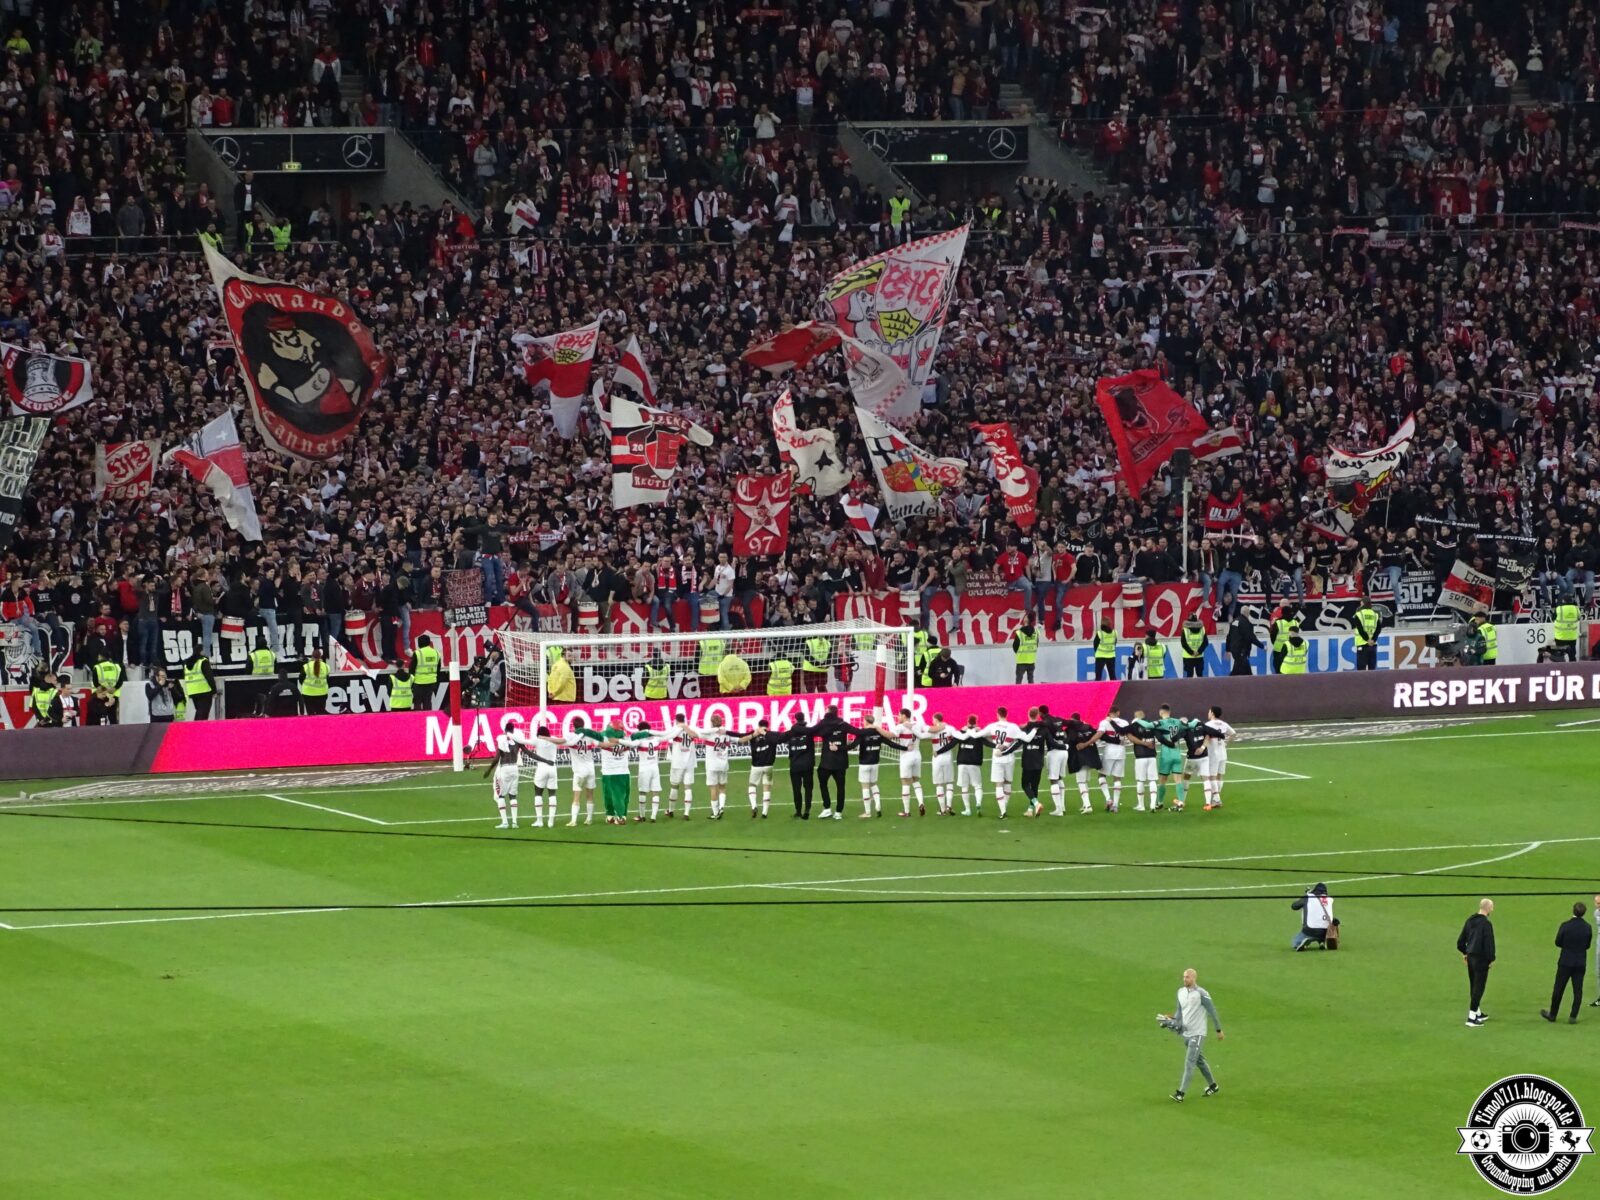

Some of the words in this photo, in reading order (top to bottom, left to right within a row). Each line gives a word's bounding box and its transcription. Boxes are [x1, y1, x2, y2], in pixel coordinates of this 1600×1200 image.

[748, 536, 774, 555] 97
[456, 611, 487, 621] IMMER
[1527, 628, 1546, 645] 36
[1399, 641, 1441, 671] 24
[1393, 677, 1521, 708] RESPEKT
[1528, 670, 1585, 702] FÜR
